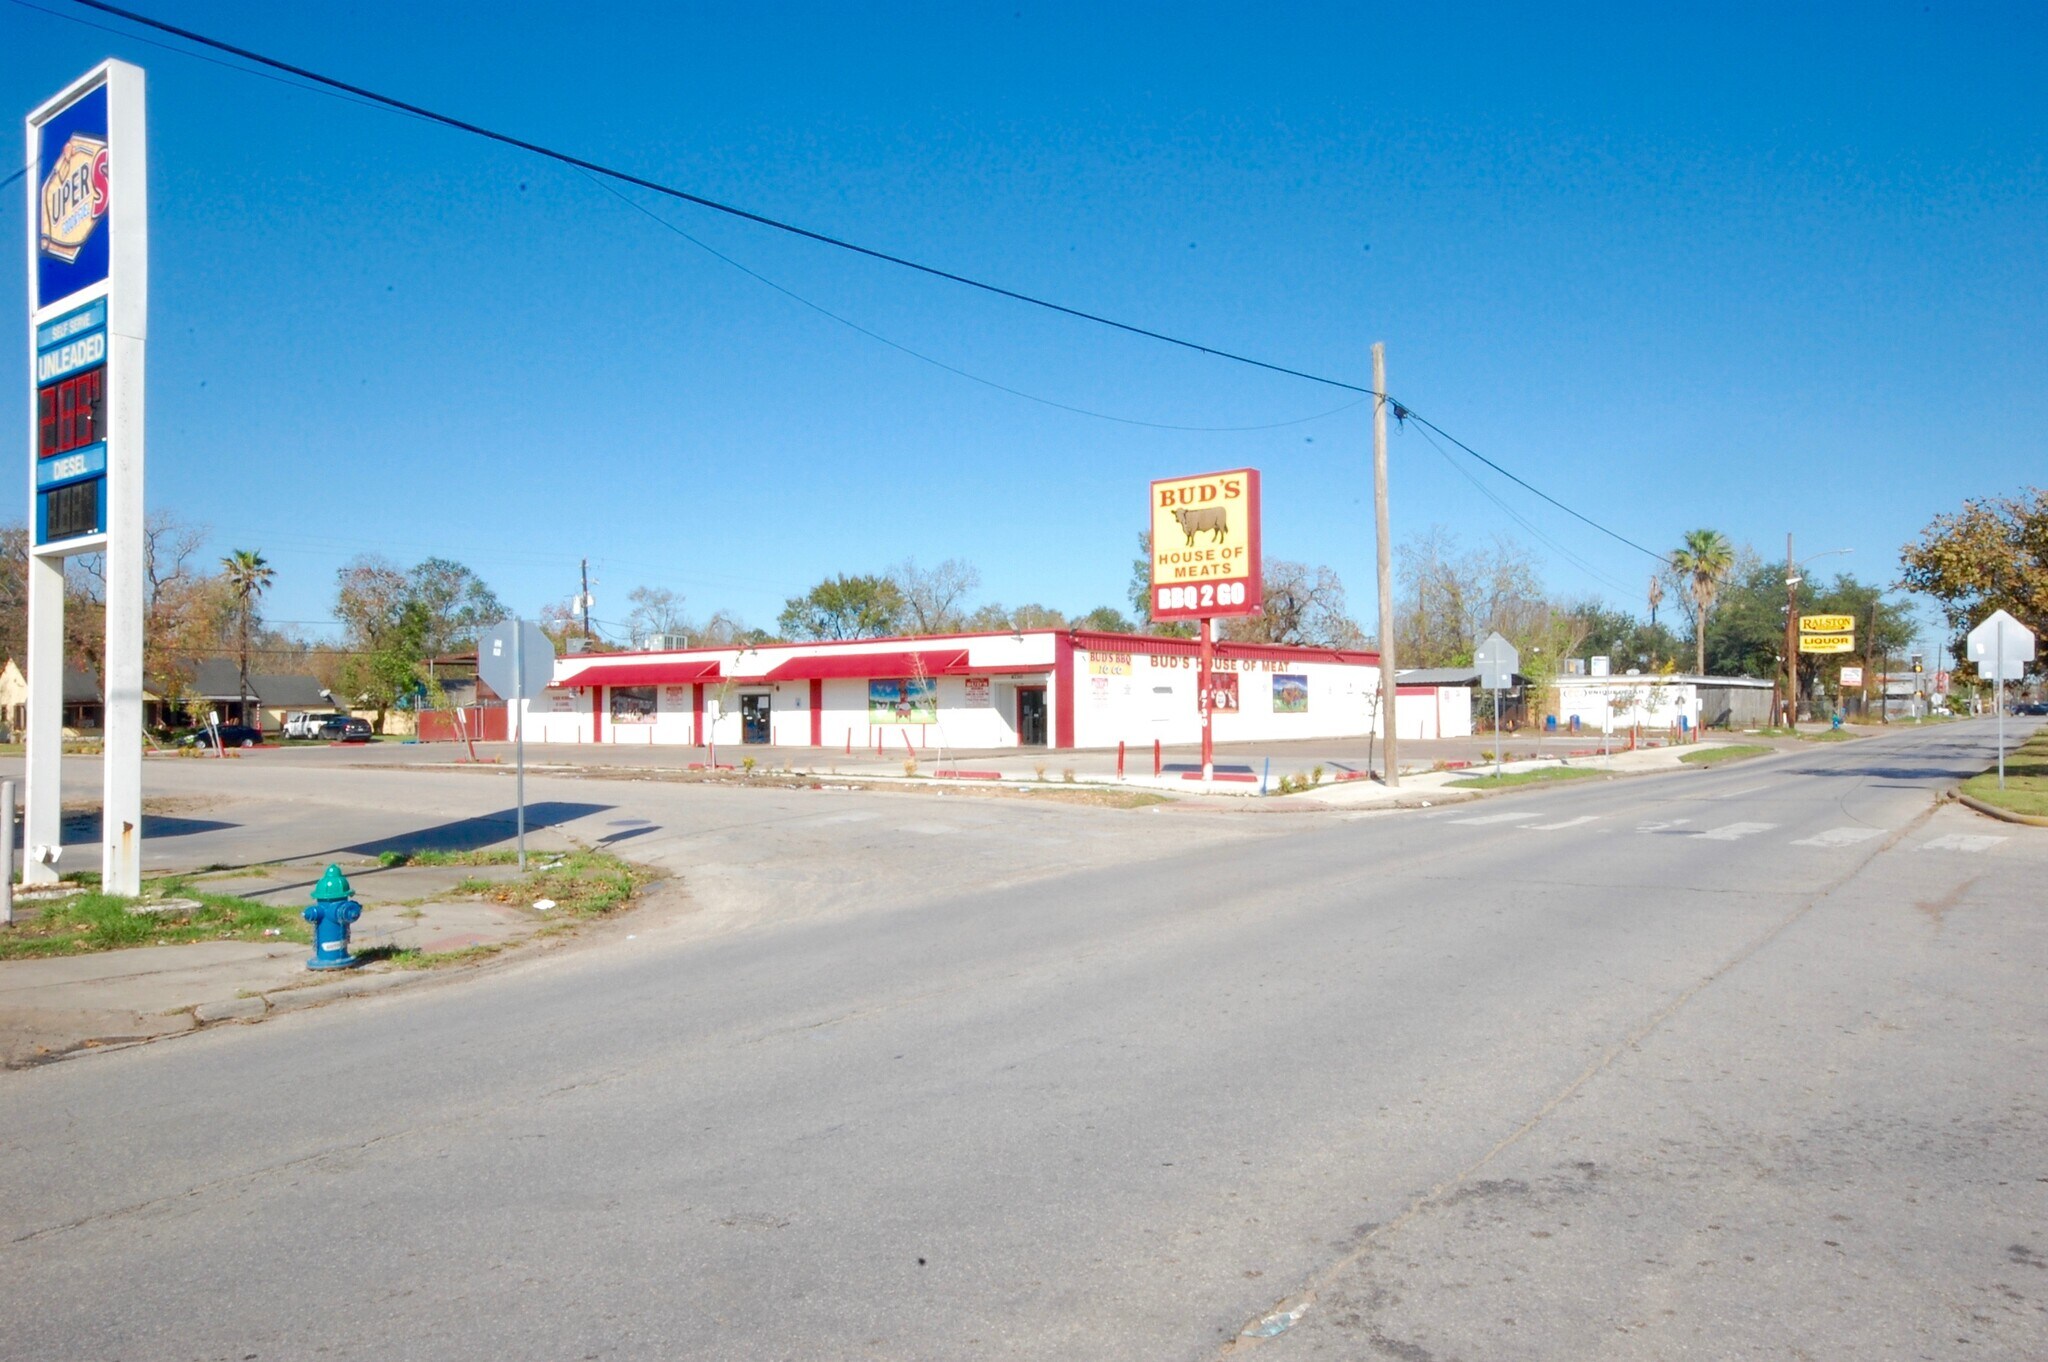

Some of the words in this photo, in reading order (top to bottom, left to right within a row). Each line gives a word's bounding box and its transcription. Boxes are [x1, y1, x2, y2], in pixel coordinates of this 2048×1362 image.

[39, 333, 104, 381] UNLEADED
[53, 453, 86, 480] DIESEL
[1160, 479, 1241, 507] BUD'S
[1159, 549, 1215, 565] HOUSE
[1221, 547, 1244, 559] OF
[1175, 563, 1232, 578] MEATS
[1158, 586, 1198, 610] BBQ
[1200, 585, 1214, 607] 2
[1217, 582, 1245, 605] GO
[1803, 617, 1851, 629] RALSTON
[1804, 637, 1848, 645] LIQUOR
[1116, 653, 1132, 666] BBQ
[1150, 655, 1190, 669] BUD'S
[1242, 659, 1256, 672] OF
[1262, 660, 1289, 673] MEAT
